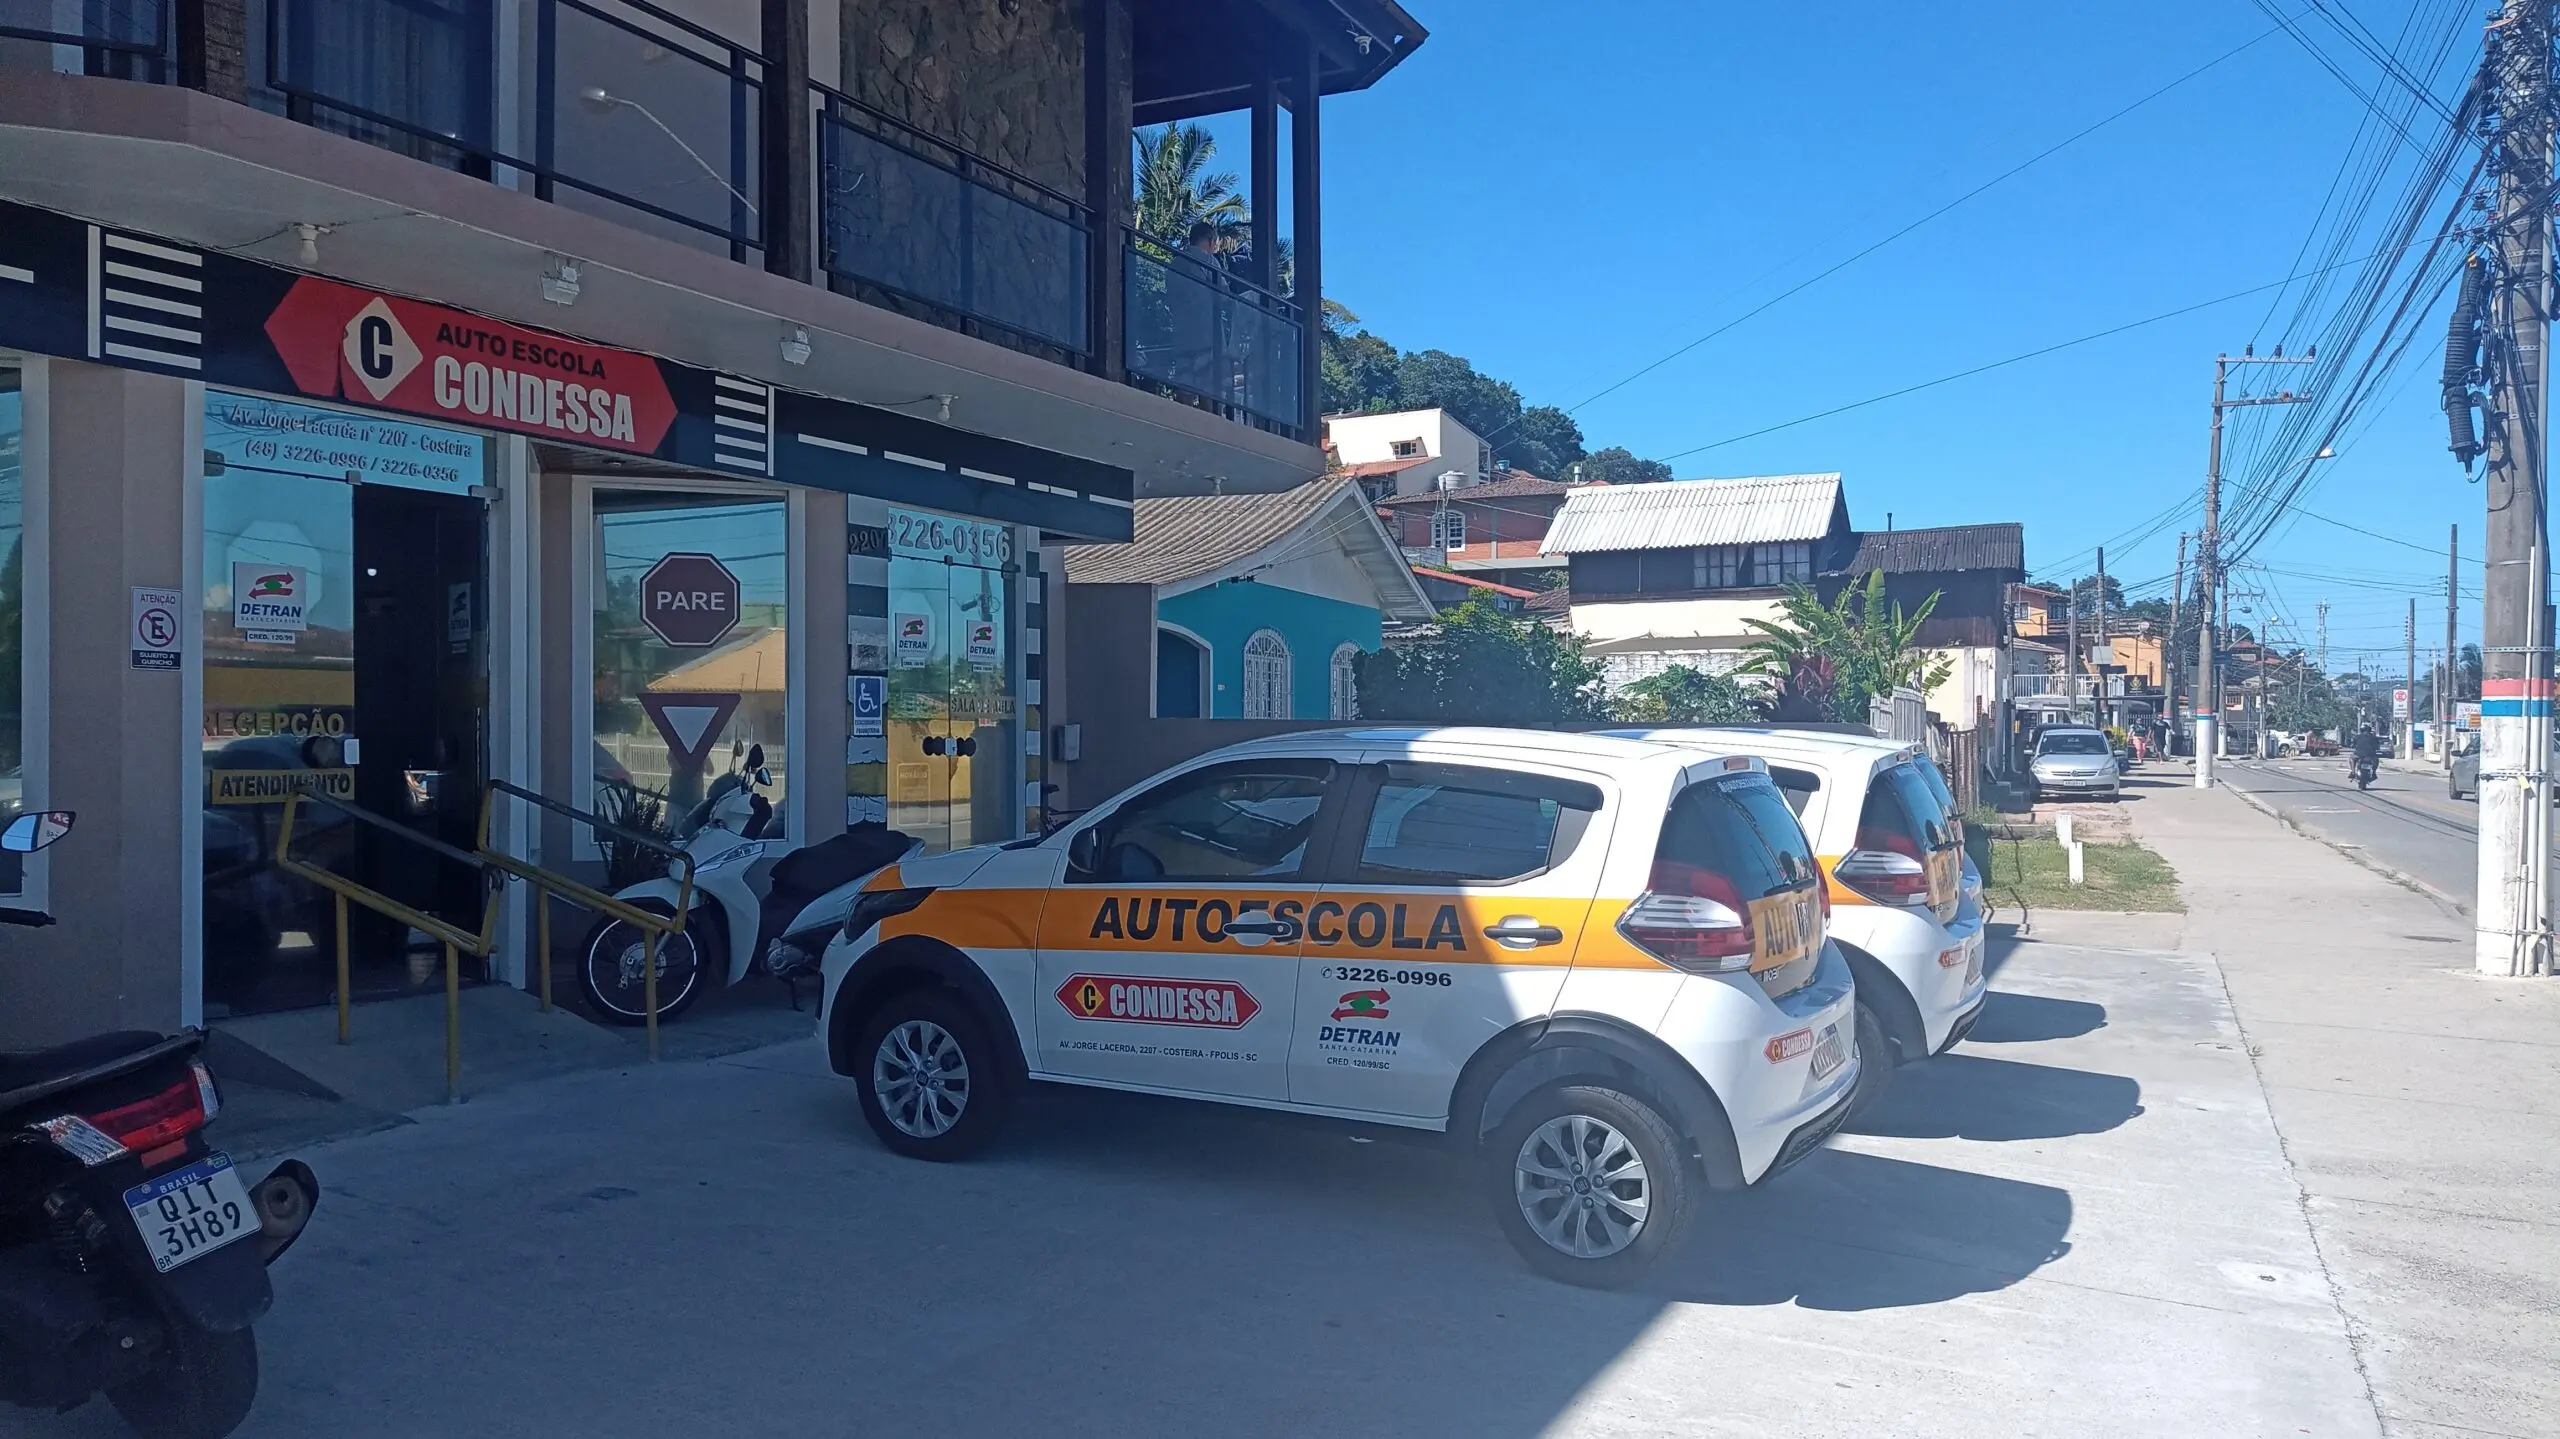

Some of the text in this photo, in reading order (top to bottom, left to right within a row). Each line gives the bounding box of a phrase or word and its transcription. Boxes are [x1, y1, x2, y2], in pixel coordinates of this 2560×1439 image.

[360, 315, 393, 379] C
[436, 322, 606, 380] AUTO ESCOLA
[434, 355, 636, 443] CONDESSA
[230, 404, 254, 427] Av.
[258, 411, 300, 435] Jorge
[302, 415, 357, 440] Lacerda
[378, 427, 408, 448] 2207
[420, 434, 473, 458] Costeira
[245, 439, 278, 461] (48)
[283, 444, 368, 470] 3226-0996
[381, 459, 460, 482] 3226-0356
[240, 603, 302, 618] DETRAN
[656, 591, 726, 611] PARE
[899, 640, 928, 649] DETRAN
[969, 647, 995, 655] DETRAN
[139, 652, 168, 660] SUJEITO
[141, 658, 173, 666] GUINCHO
[1336, 966, 1452, 987] 3226-0996
[1083, 984, 1096, 1010] C
[1109, 983, 1239, 1023] CONDESSA
[1319, 1026, 1401, 1047] DETRAN
[1059, 1041, 1070, 1049] AV.
[1072, 1041, 1098, 1051] JORGE
[1099, 1043, 1138, 1054] LACERDA,
[1139, 1046, 1157, 1054] 2207
[1163, 1047, 1204, 1058] COSTEIRA
[1210, 1050, 1239, 1061] FPOLIS
[1246, 1053, 1258, 1062] SC
[1319, 1043, 1398, 1056] SANTA CATARINA
[1353, 1060, 1390, 1070] 120/99/SC
[160, 1172, 201, 1194] BRASIL
[156, 1176, 219, 1223] QIT
[158, 1201, 240, 1257] 3H89
[158, 1254, 173, 1269] BR
